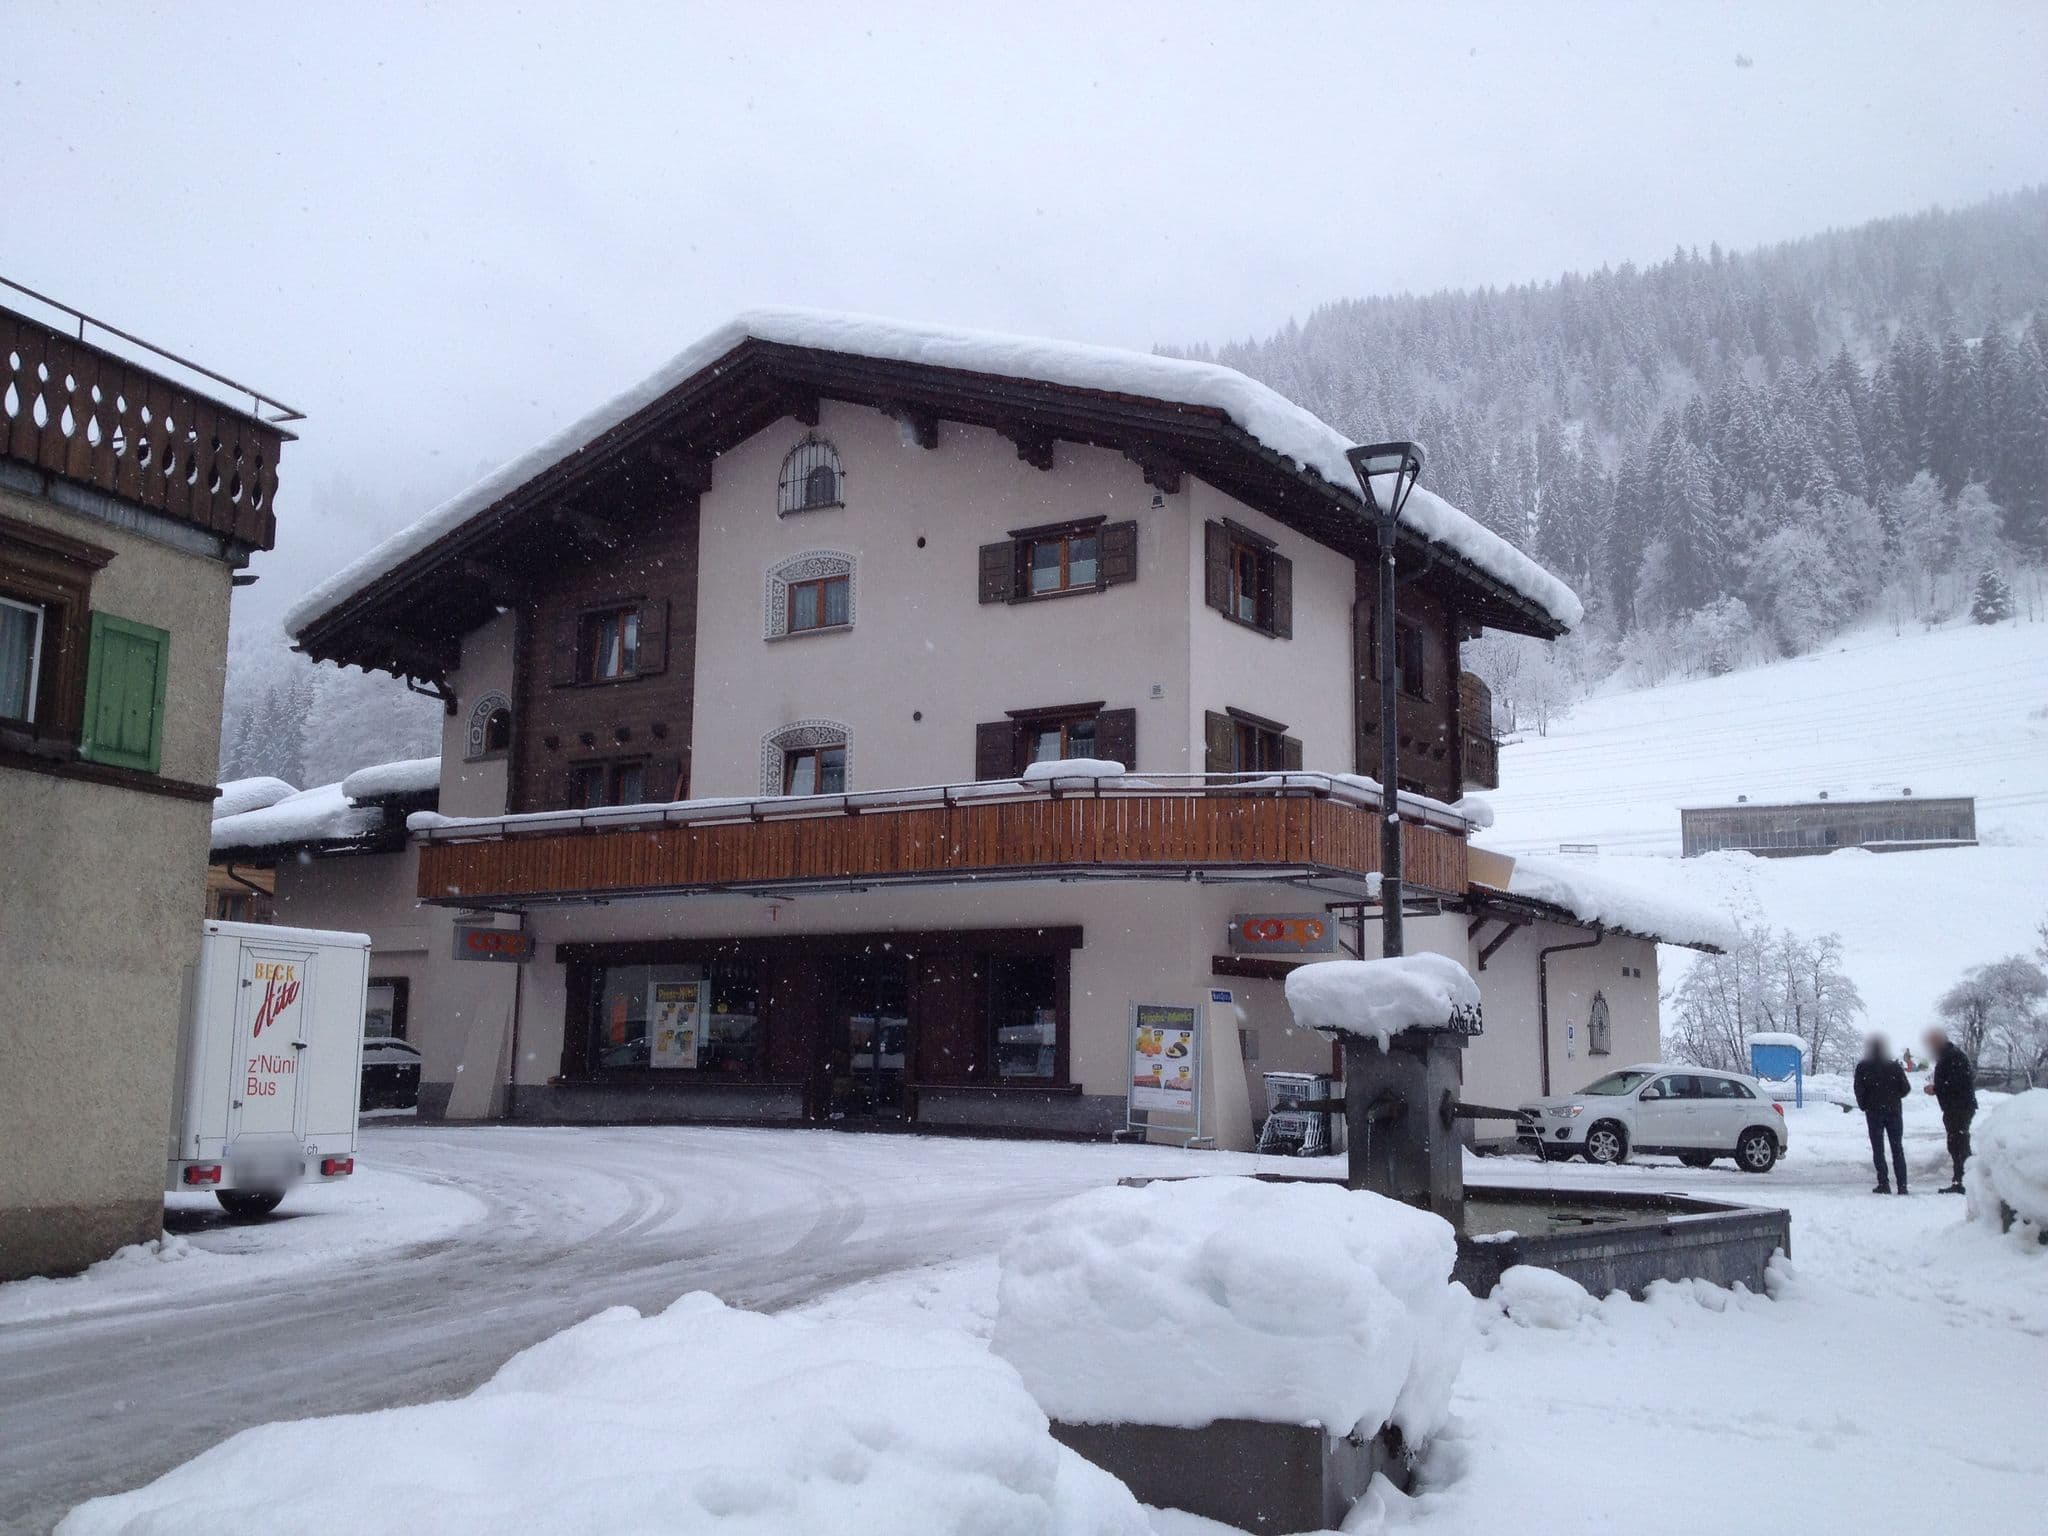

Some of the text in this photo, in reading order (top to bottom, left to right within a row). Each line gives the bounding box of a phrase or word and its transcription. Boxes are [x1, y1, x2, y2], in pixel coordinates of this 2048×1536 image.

[255, 962, 295, 982] BECK
[248, 1055, 295, 1074] z'Nüni
[246, 1076, 276, 1096] Bus
